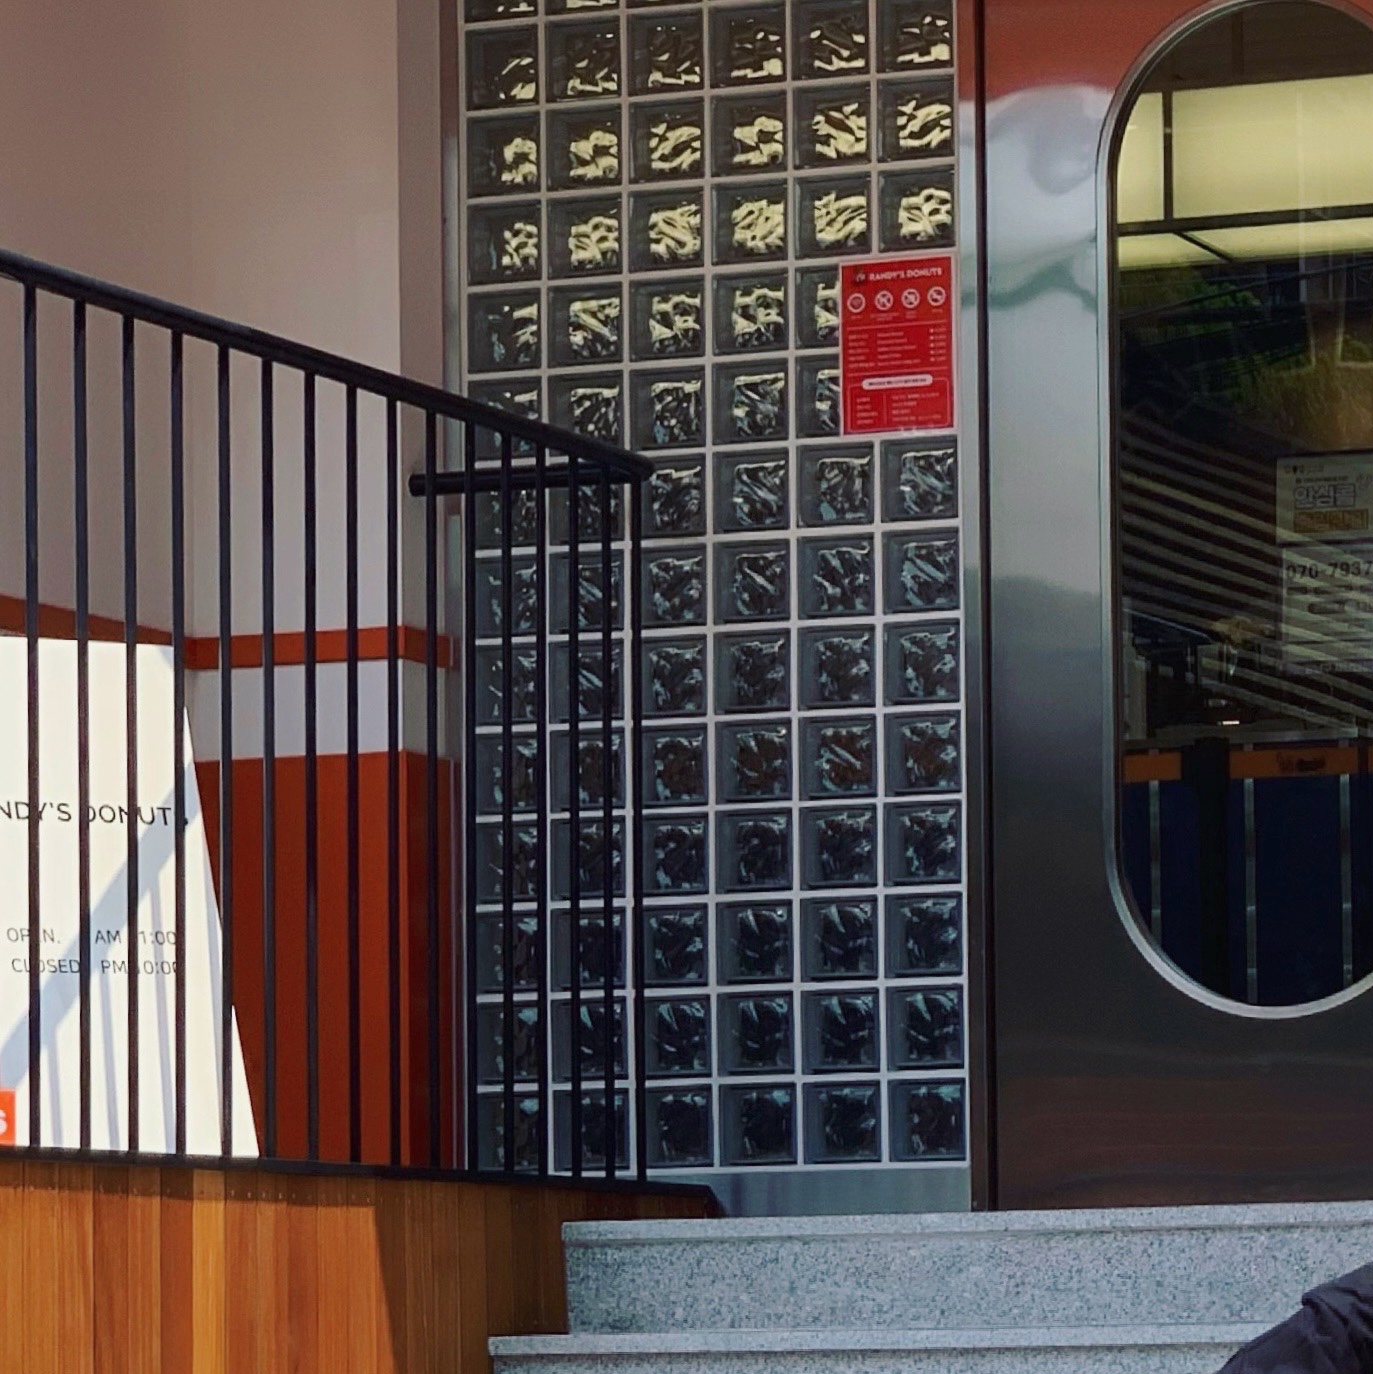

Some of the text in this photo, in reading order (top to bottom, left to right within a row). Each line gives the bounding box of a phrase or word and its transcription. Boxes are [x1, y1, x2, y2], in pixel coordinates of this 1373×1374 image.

[906, 267, 943, 278] DONUTS
[86, 804, 188, 828] ONUT
[6, 927, 61, 944] OPN.
[95, 930, 122, 945] AM
[101, 959, 128, 975] PM
